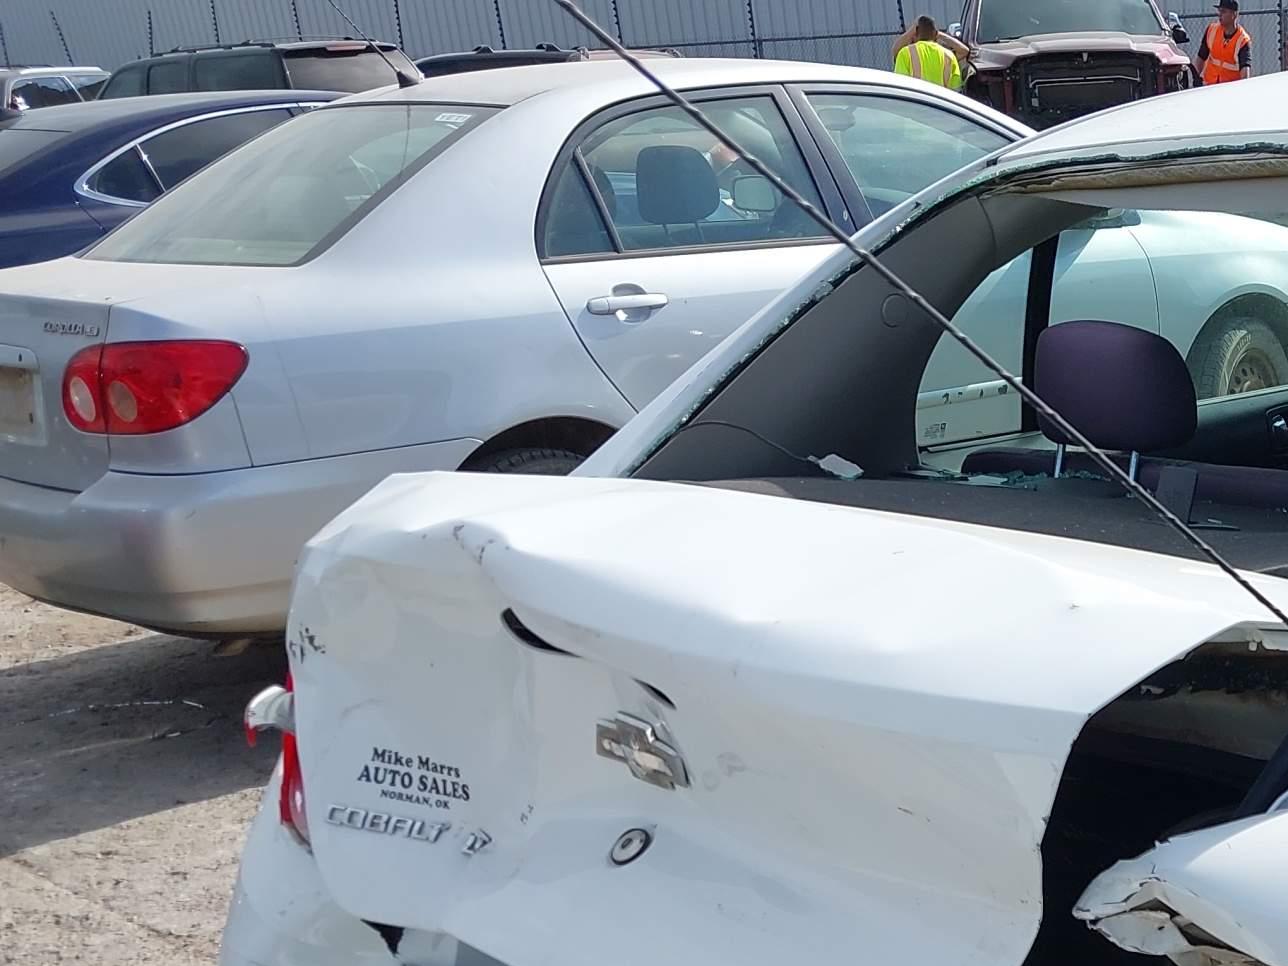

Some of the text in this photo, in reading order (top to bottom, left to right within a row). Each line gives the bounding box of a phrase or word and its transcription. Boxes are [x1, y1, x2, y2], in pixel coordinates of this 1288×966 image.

[371, 747, 460, 779] Mike Marrs
[357, 765, 471, 802] AUTO SALES
[380, 789, 451, 811] NORMAN, OK
[326, 803, 451, 844] COBALT
